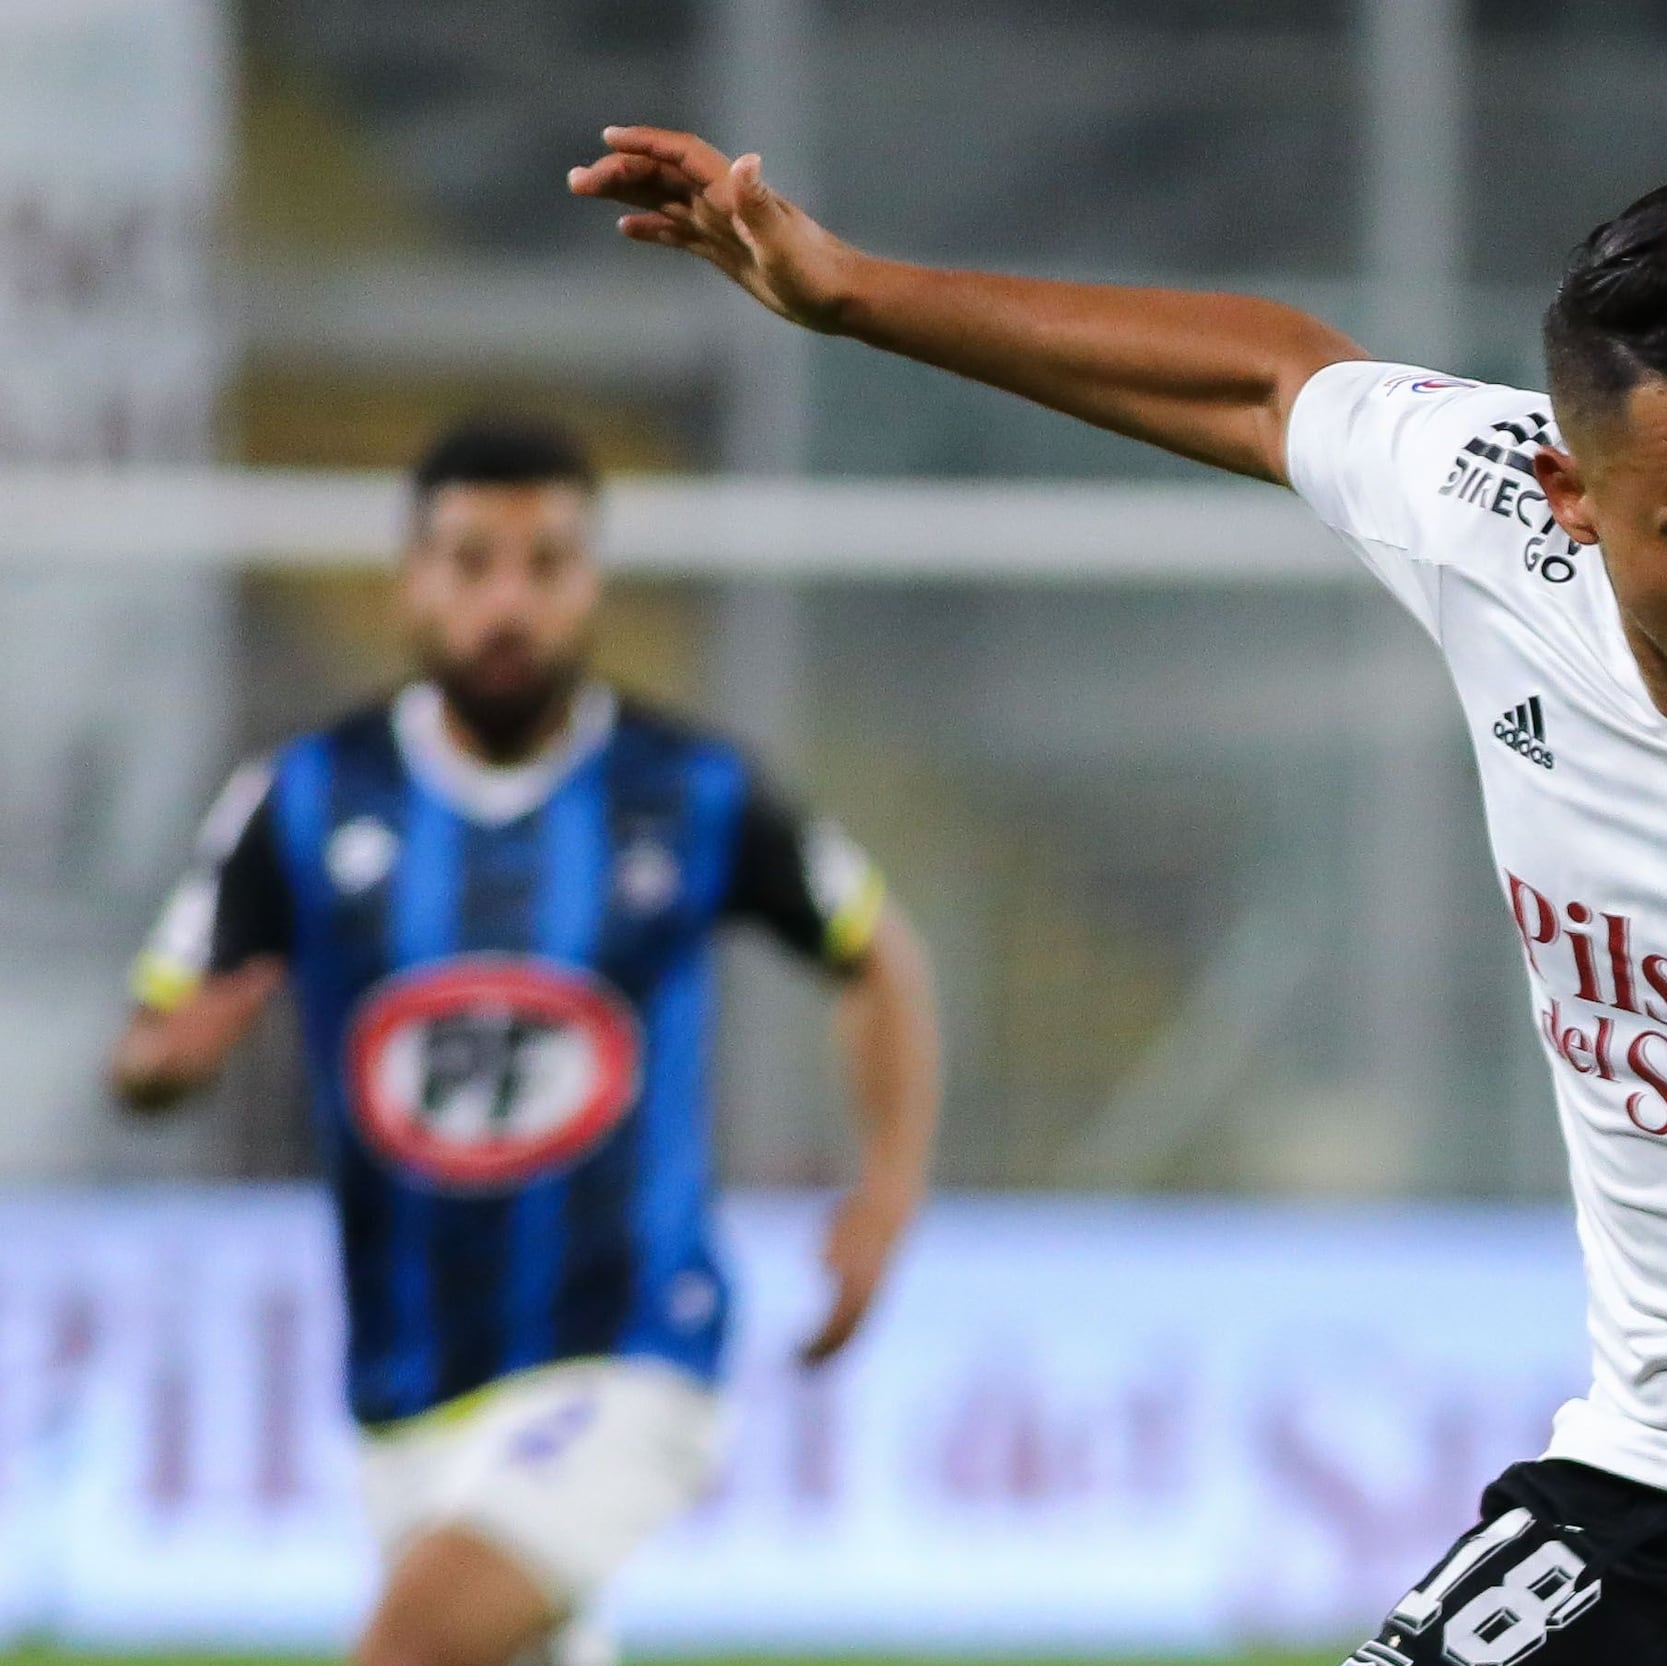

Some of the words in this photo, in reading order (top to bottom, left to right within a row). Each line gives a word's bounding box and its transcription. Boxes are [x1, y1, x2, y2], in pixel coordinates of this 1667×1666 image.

[1525, 536, 1577, 583] GO
[1493, 720, 1554, 770] adidas
[1542, 997, 1622, 1084] del
